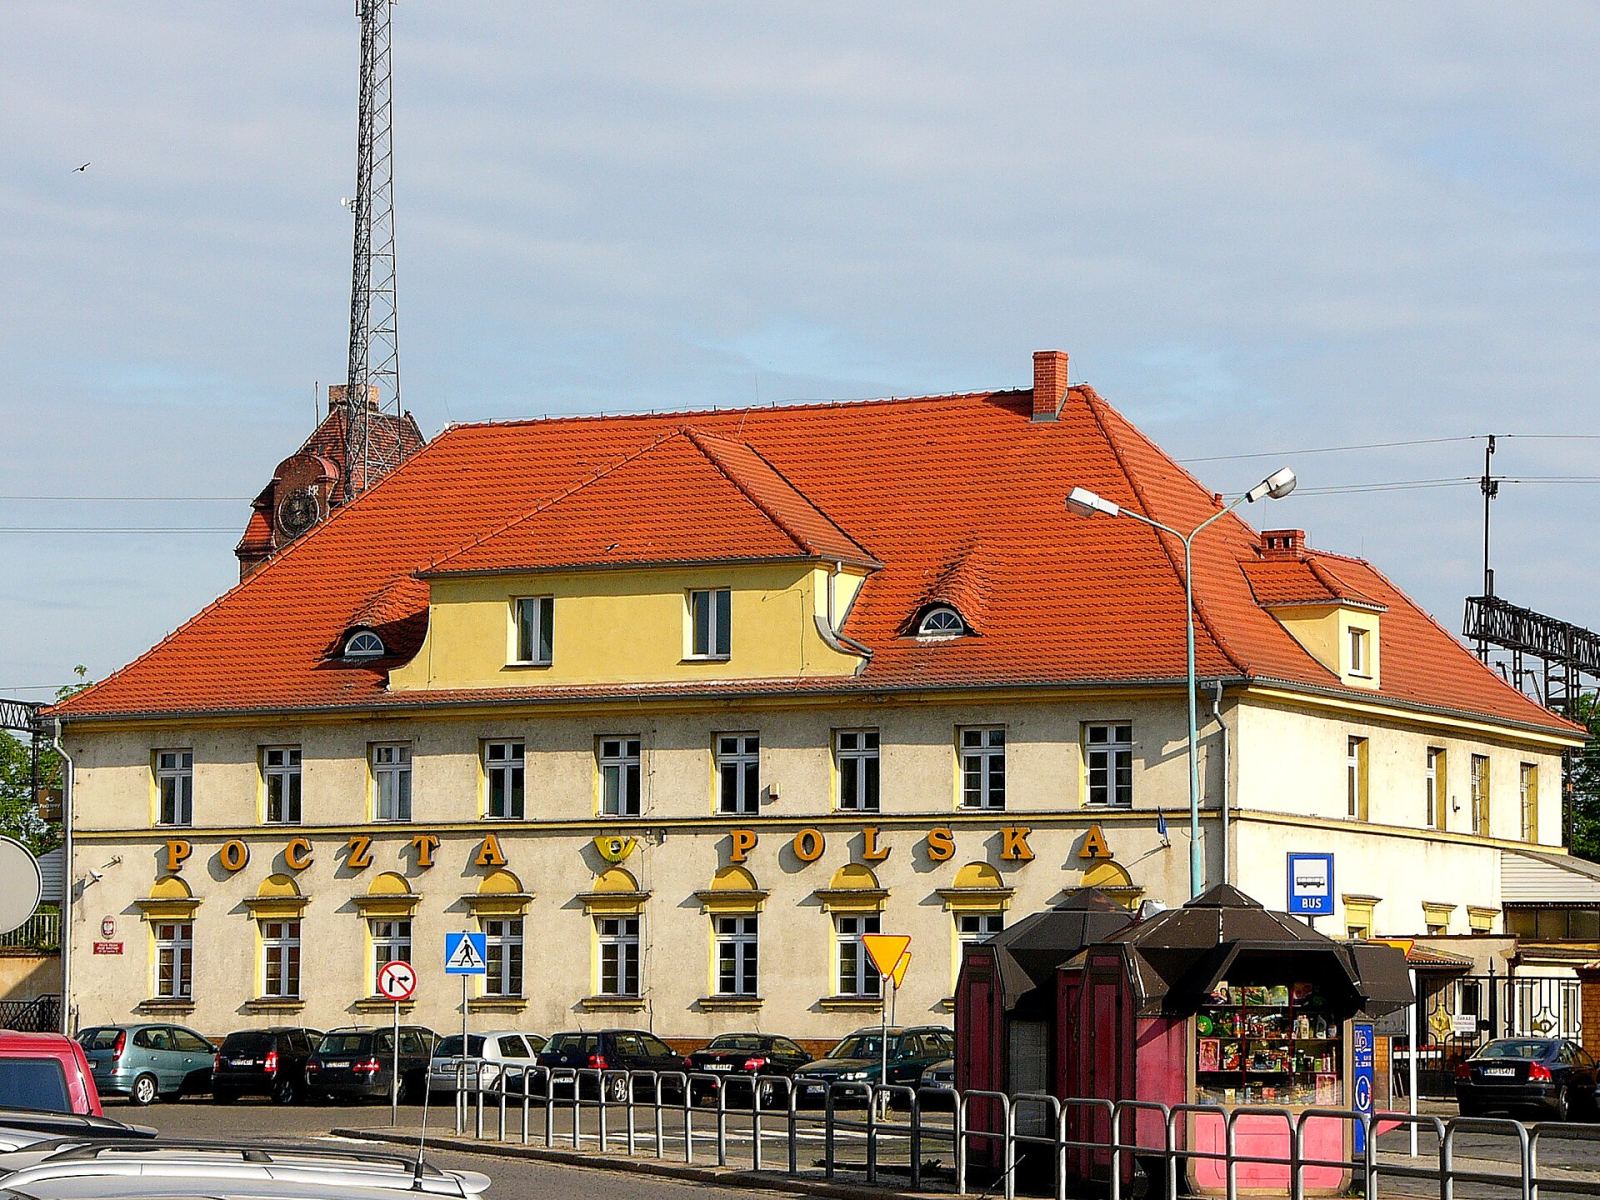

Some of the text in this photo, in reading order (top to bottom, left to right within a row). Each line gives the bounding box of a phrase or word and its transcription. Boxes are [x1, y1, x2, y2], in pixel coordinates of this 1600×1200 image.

[166, 824, 1114, 871] POCZTA POLSKA
[1302, 898, 1322, 909] BUS
